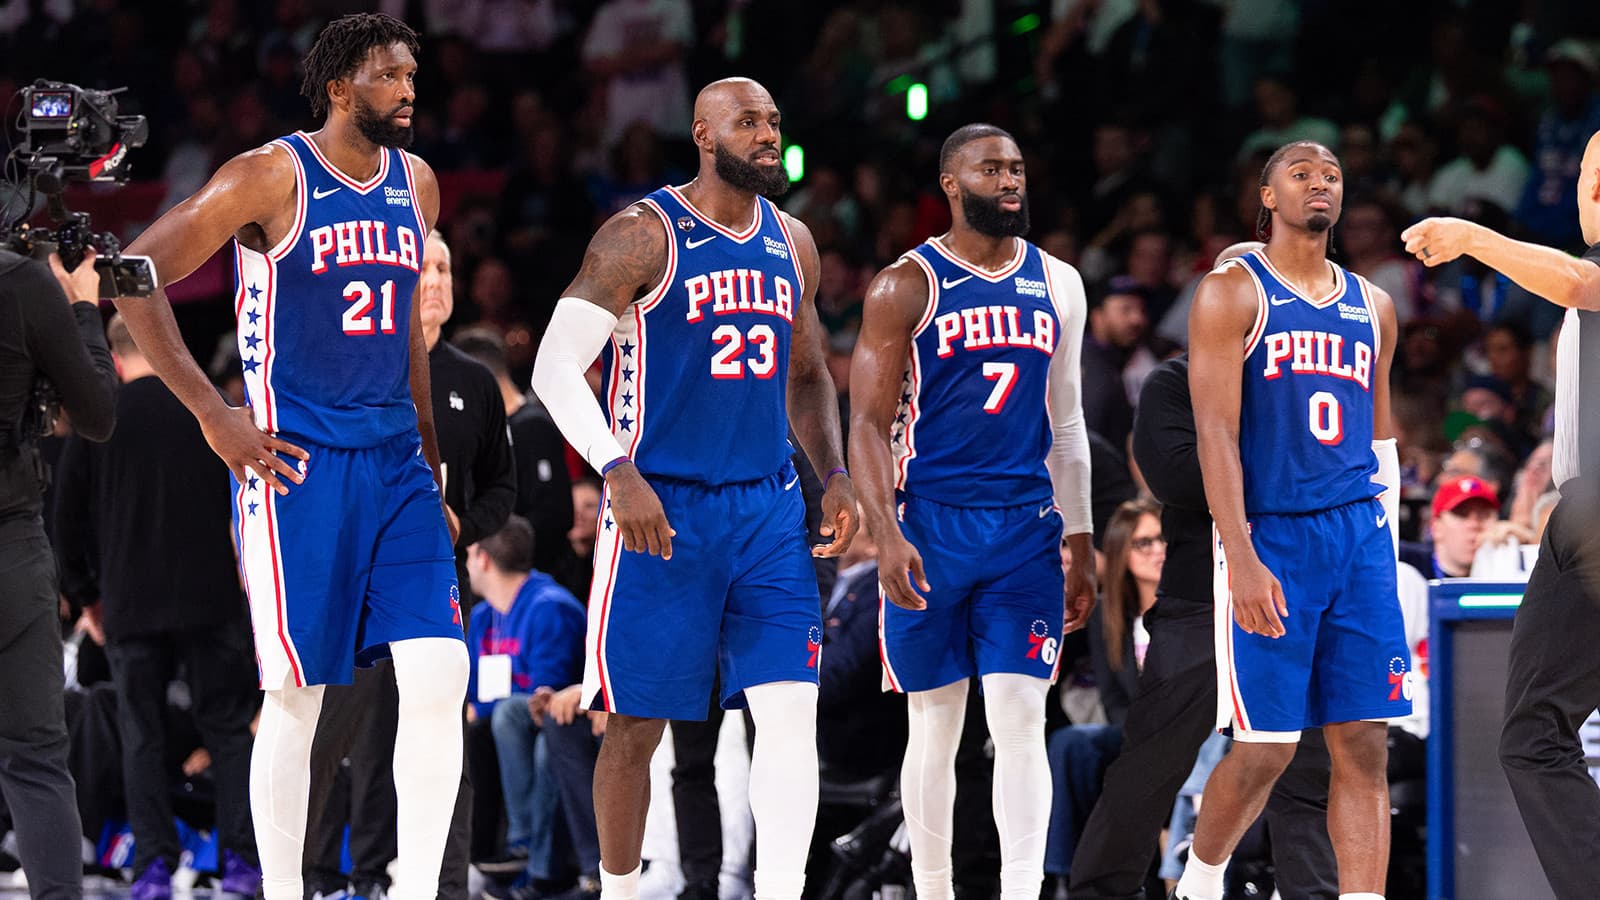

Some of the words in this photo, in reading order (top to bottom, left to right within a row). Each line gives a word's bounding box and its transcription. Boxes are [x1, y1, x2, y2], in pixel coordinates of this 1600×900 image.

[384, 186, 409, 197] Bloom
[386, 197, 410, 207] energy
[310, 220, 421, 275] PHILA
[763, 236, 787, 251] Bloom
[765, 246, 788, 260] energy
[684, 268, 794, 325] PHILA
[1015, 277, 1046, 289] Bloom
[1016, 287, 1046, 298] energy
[342, 280, 395, 335] 21
[1337, 302, 1368, 315] Bloom
[1340, 311, 1369, 324] energy
[935, 305, 1055, 359] PHILA
[711, 324, 778, 379] 23
[1264, 331, 1372, 392] PHILA
[982, 362, 1019, 414] 7
[1309, 391, 1344, 446] 0
[806, 639, 822, 669] 7
[1025, 632, 1057, 665] 76
